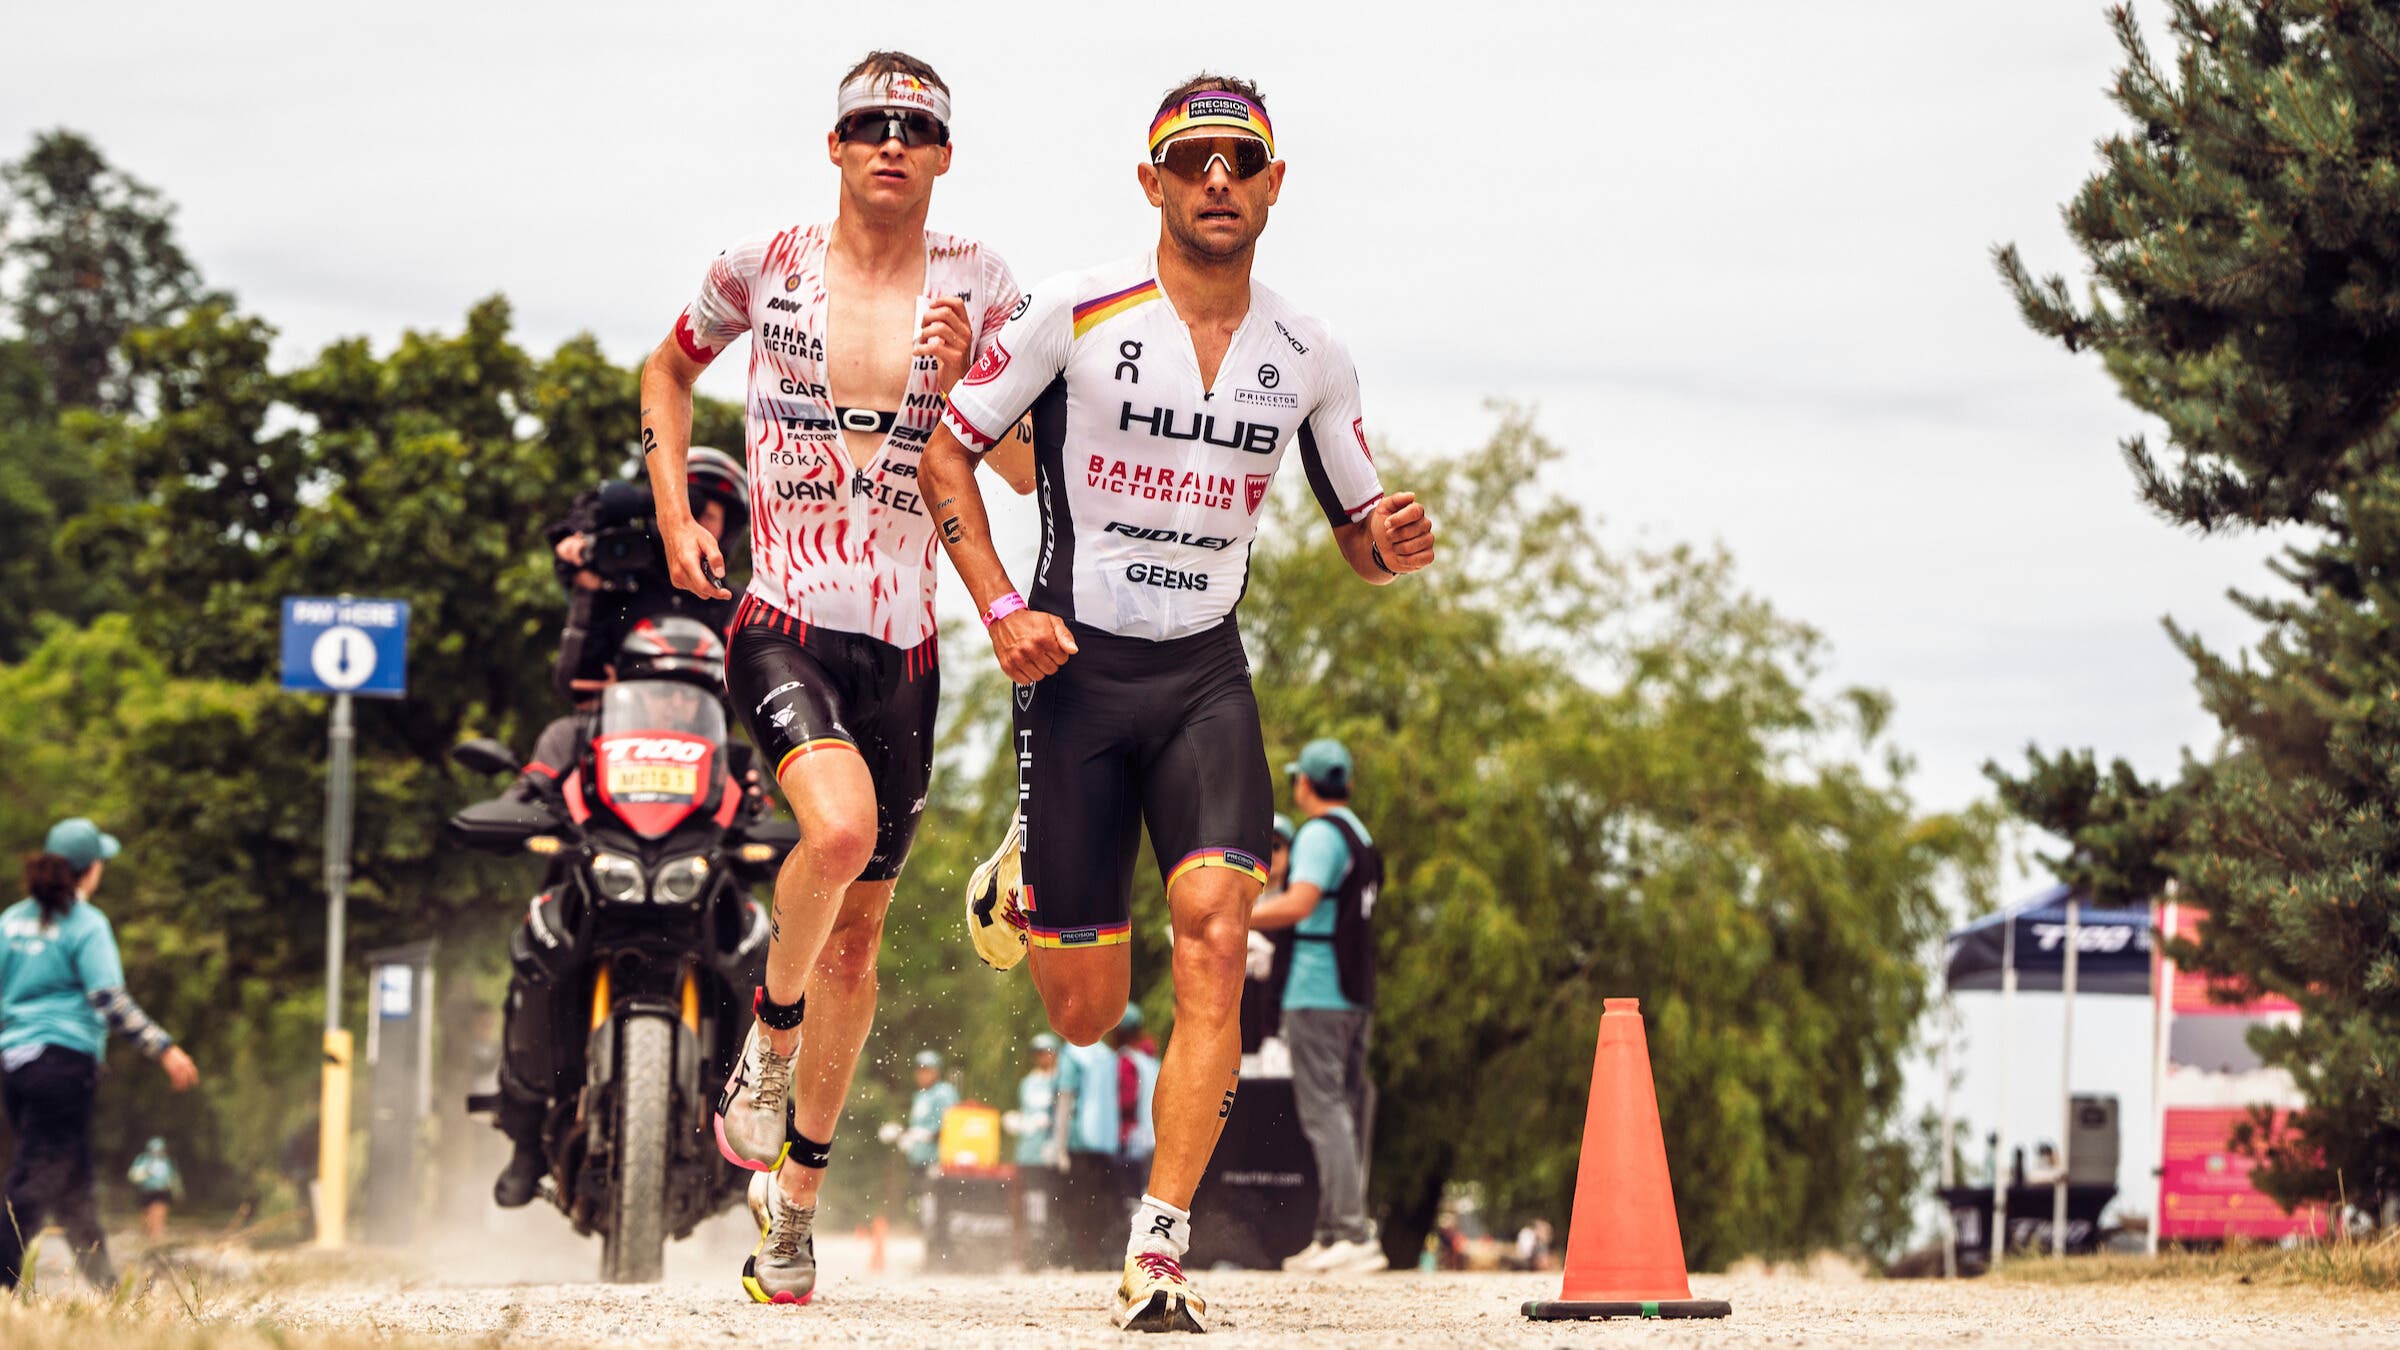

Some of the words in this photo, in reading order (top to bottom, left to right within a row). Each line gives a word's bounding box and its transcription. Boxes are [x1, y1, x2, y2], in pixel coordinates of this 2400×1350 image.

[889, 89, 914, 102] Red
[915, 94, 936, 108] Bull
[1190, 100, 1247, 113] PRECISION
[1191, 108, 1207, 116] FUEL
[1214, 108, 1248, 119] HYDRATION
[767, 297, 802, 314] RAW
[1239, 392, 1296, 404] PRINCETON
[643, 427, 658, 456] 2
[787, 432, 838, 441] FACTORY
[1119, 401, 1279, 455] HUUB
[1088, 454, 1235, 496] BAHRAIN
[775, 480, 836, 500] VAN
[852, 477, 923, 516] RIEL
[1087, 473, 1232, 510] VICTORIOUS
[1039, 463, 1055, 587] RIDLEY
[1104, 521, 1238, 551] RIDLEY
[1126, 563, 1208, 591] GEENS
[601, 738, 707, 762] T100
[1019, 729, 1032, 853] HUUB
[1062, 931, 1096, 939] PRECISION
[2030, 922, 2134, 952] T00
